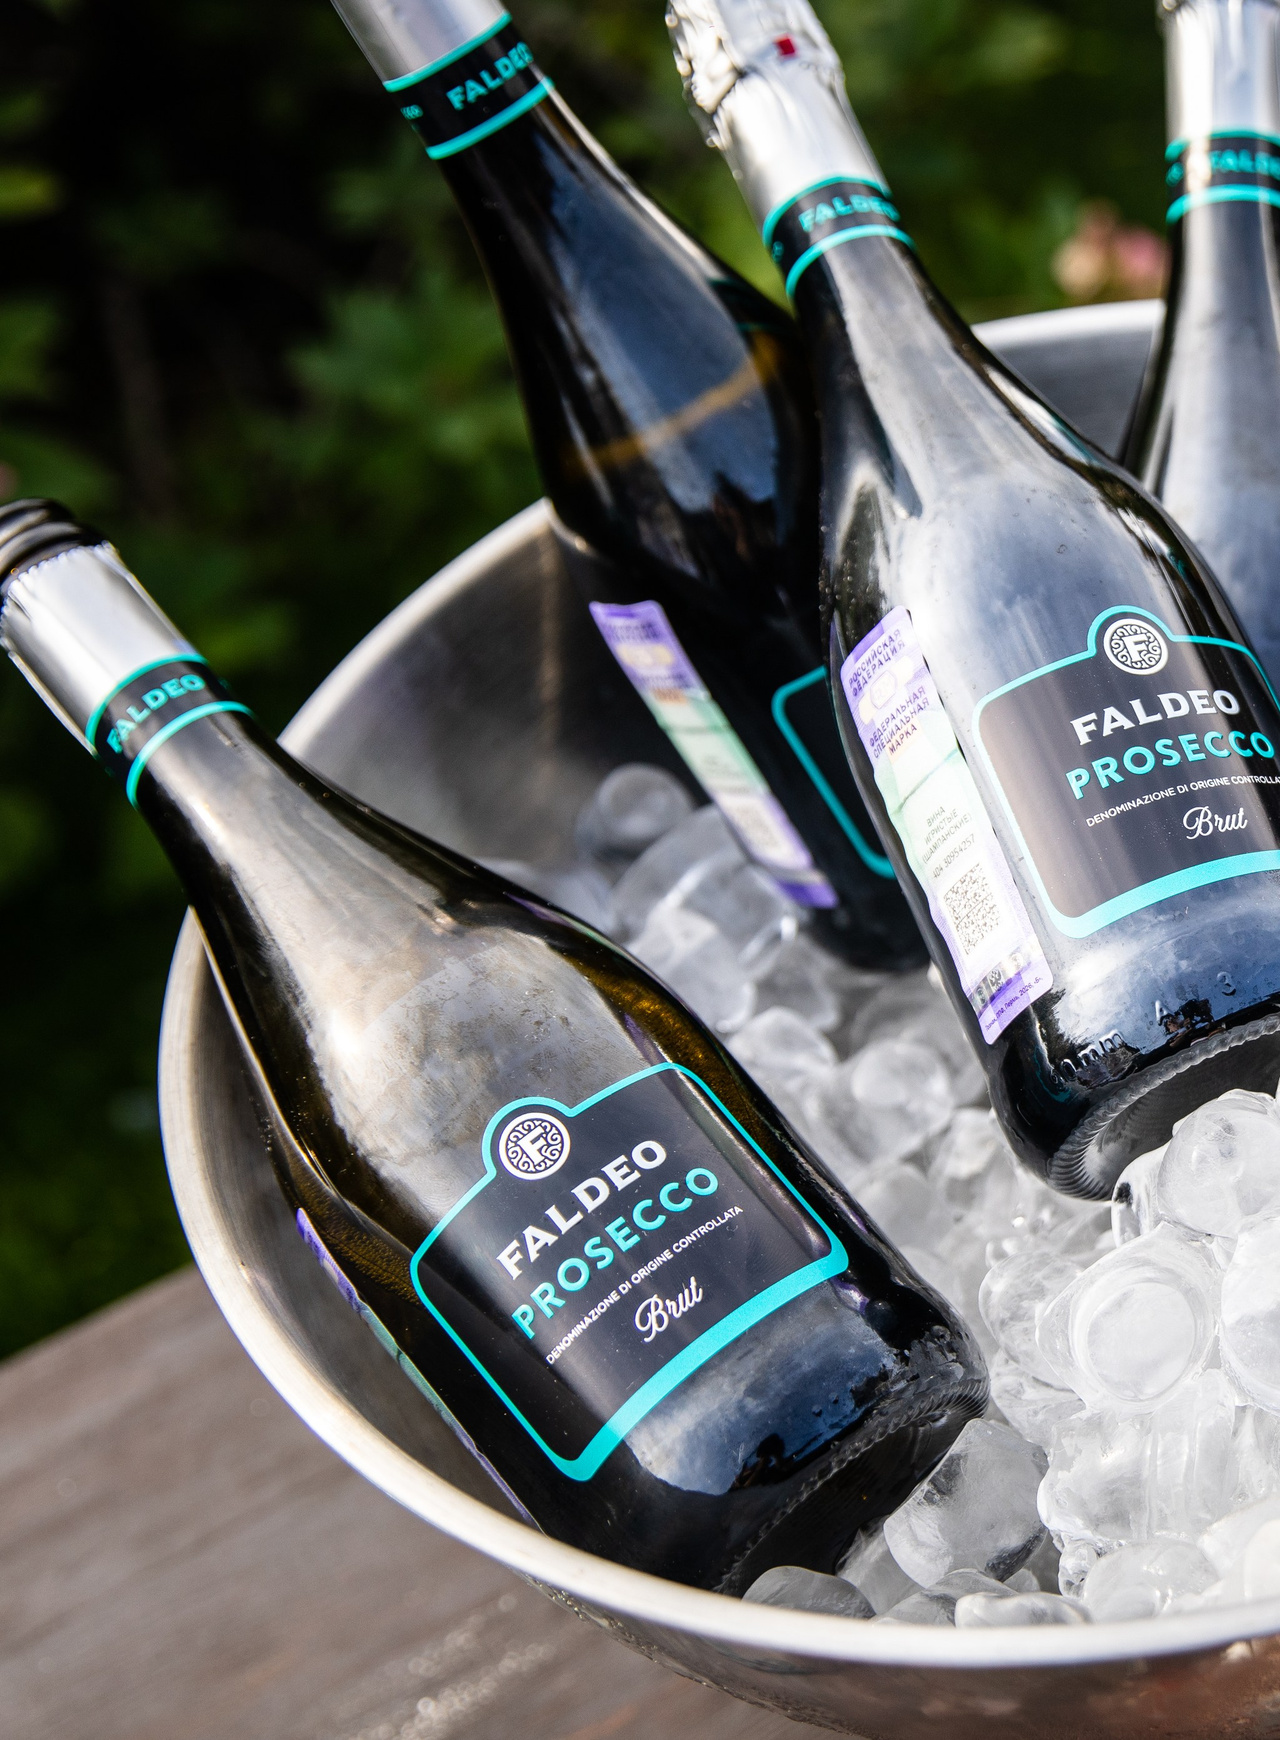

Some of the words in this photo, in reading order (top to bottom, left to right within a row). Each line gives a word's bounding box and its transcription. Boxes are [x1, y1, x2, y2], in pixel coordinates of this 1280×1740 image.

[446, 41, 534, 111] FALDEO
[798, 194, 901, 233] FALDEO
[848, 628, 902, 689] РОССИЙСКАЯ
[852, 639, 906, 697] ФЕДЕРАЦИЯ
[107, 674, 206, 754] FALDEO
[869, 685, 927, 748] ФЕДЕРАЛЬНАЯ
[872, 697, 930, 760] СПЕЦИАЛЬНАЯ
[887, 722, 918, 756] МАРКА
[1070, 689, 1241, 746] FALDEO
[1065, 731, 1275, 800] PROSECCO
[924, 808, 958, 846] ИГРИСТЫЕ
[926, 806, 946, 827] ВИНА
[1086, 787, 1178, 827] DENOMINAZIONE
[1177, 783, 1189, 795] DI
[1189, 777, 1231, 793] ORIGINE
[1183, 806, 1249, 841] Brut
[496, 1140, 668, 1281] FALDEO
[511, 1167, 720, 1340] PROSECCO
[545, 1293, 619, 1365] DENOMINAZIONE
[617, 1279, 632, 1294] DI
[630, 1249, 674, 1287] ORIGINE
[671, 1205, 744, 1253] CONTROLLATA
[634, 1275, 704, 1343] Brut
